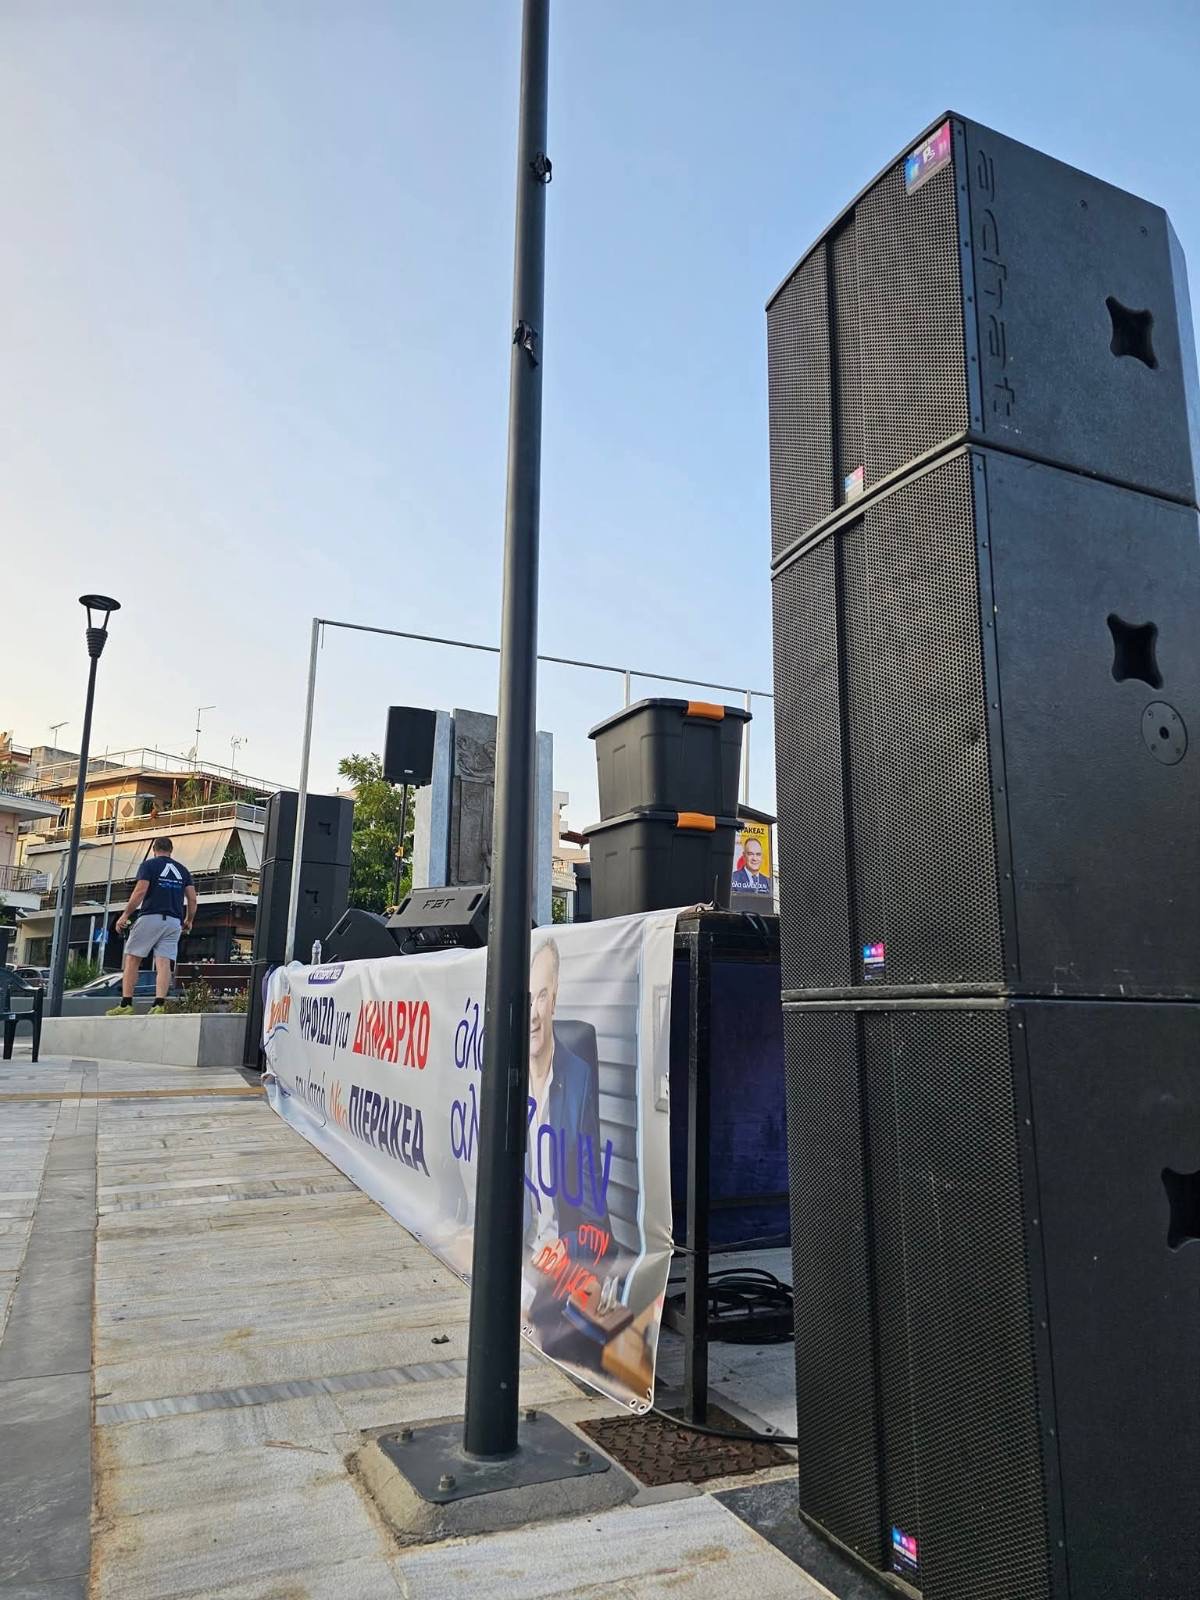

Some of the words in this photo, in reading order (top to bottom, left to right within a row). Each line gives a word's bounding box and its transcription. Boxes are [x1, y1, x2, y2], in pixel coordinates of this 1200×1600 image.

[422, 898, 456, 910] FBT
[300, 996, 335, 1046] ΨΗΦΙΖΩ
[333, 1011, 351, 1061] για
[352, 999, 432, 1070] ΔΗΜΑΡΧΟ
[349, 1084, 431, 1177] ΠΙΕΡΑΚΕΑ
